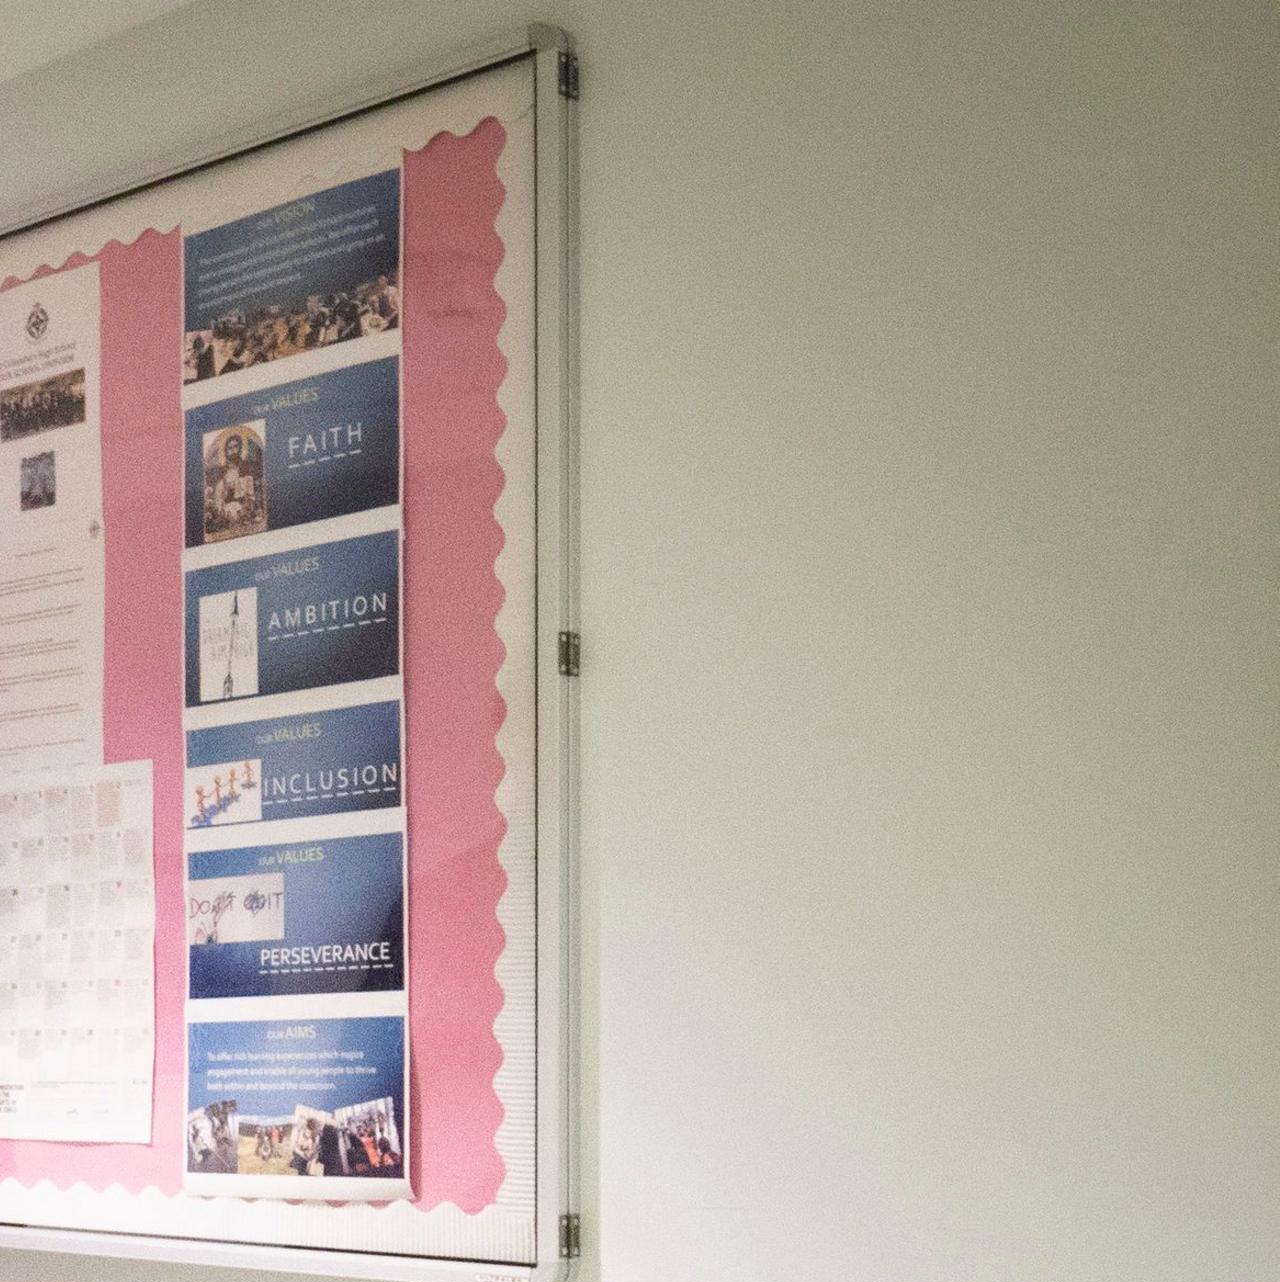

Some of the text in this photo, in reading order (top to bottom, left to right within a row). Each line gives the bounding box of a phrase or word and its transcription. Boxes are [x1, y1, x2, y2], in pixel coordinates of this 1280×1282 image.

[271, 387, 319, 411] VALUES
[287, 422, 362, 459] FAITH
[272, 557, 320, 578] VALUES
[268, 591, 388, 630] AMBITION
[274, 723, 322, 741] VALUES
[263, 762, 397, 797] INCLUSION
[276, 846, 325, 864] VALUES
[260, 942, 391, 966] PERSEVERANCE
[286, 1025, 316, 1040] AIMS
